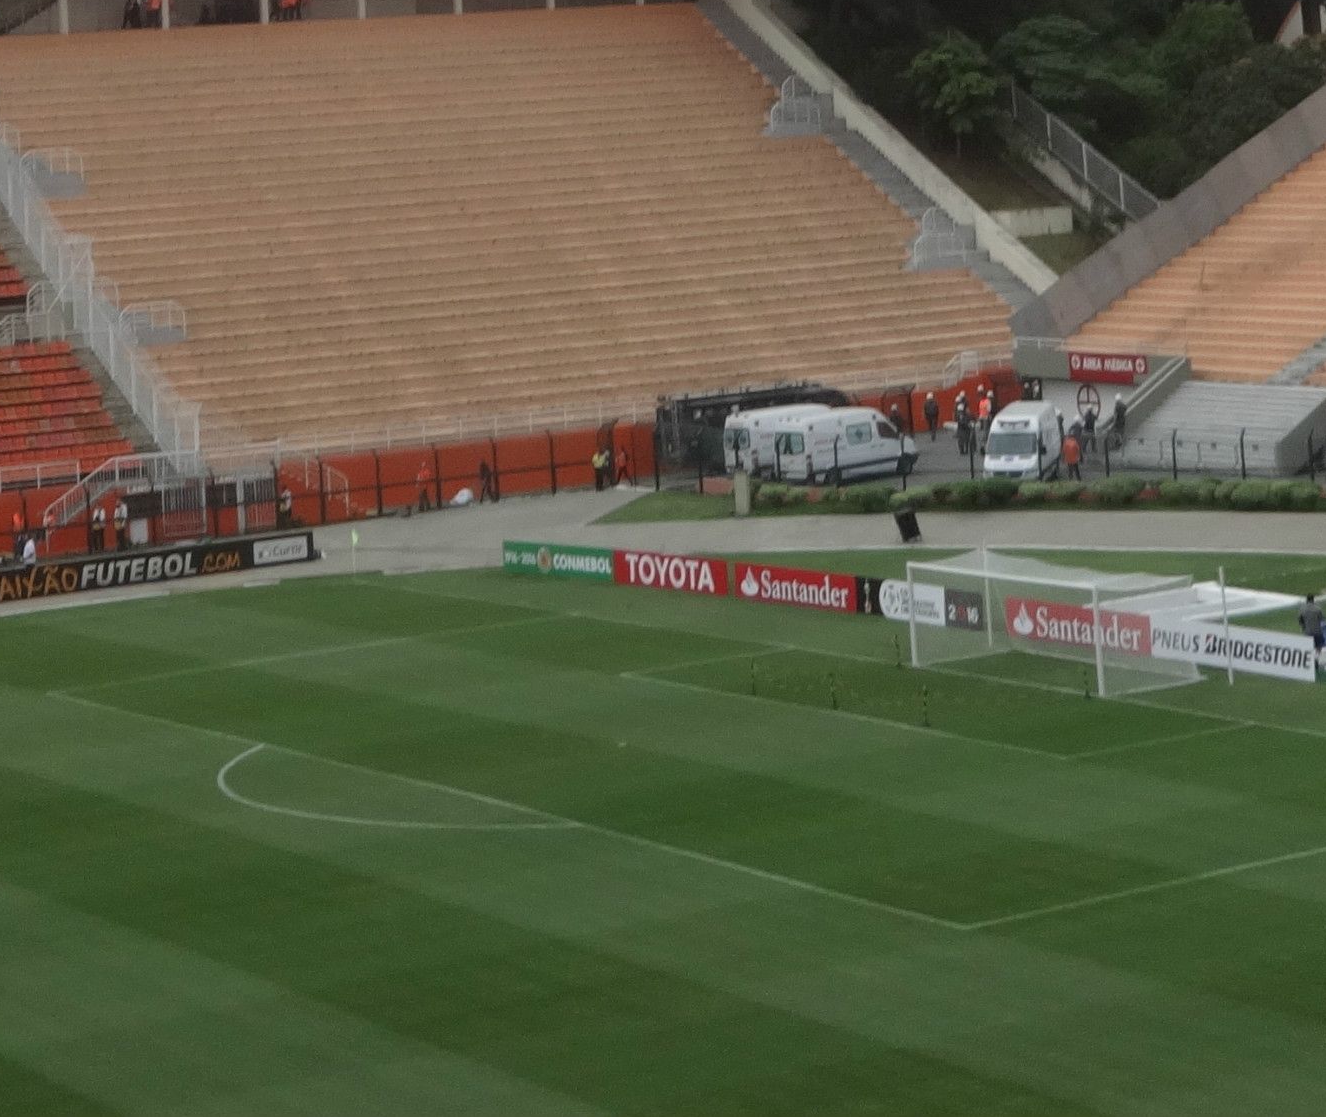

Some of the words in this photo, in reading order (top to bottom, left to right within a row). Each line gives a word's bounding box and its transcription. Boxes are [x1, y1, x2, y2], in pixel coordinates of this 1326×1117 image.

[80, 550, 198, 588] FUTEBOL
[553, 553, 612, 574] CONMEBOL
[625, 552, 715, 593] TOYOTA
[761, 570, 850, 608] Santander
[1035, 607, 1143, 651] Santander
[1152, 627, 1201, 654] PNEUS
[1204, 633, 1313, 670] BRIDGESTONE
